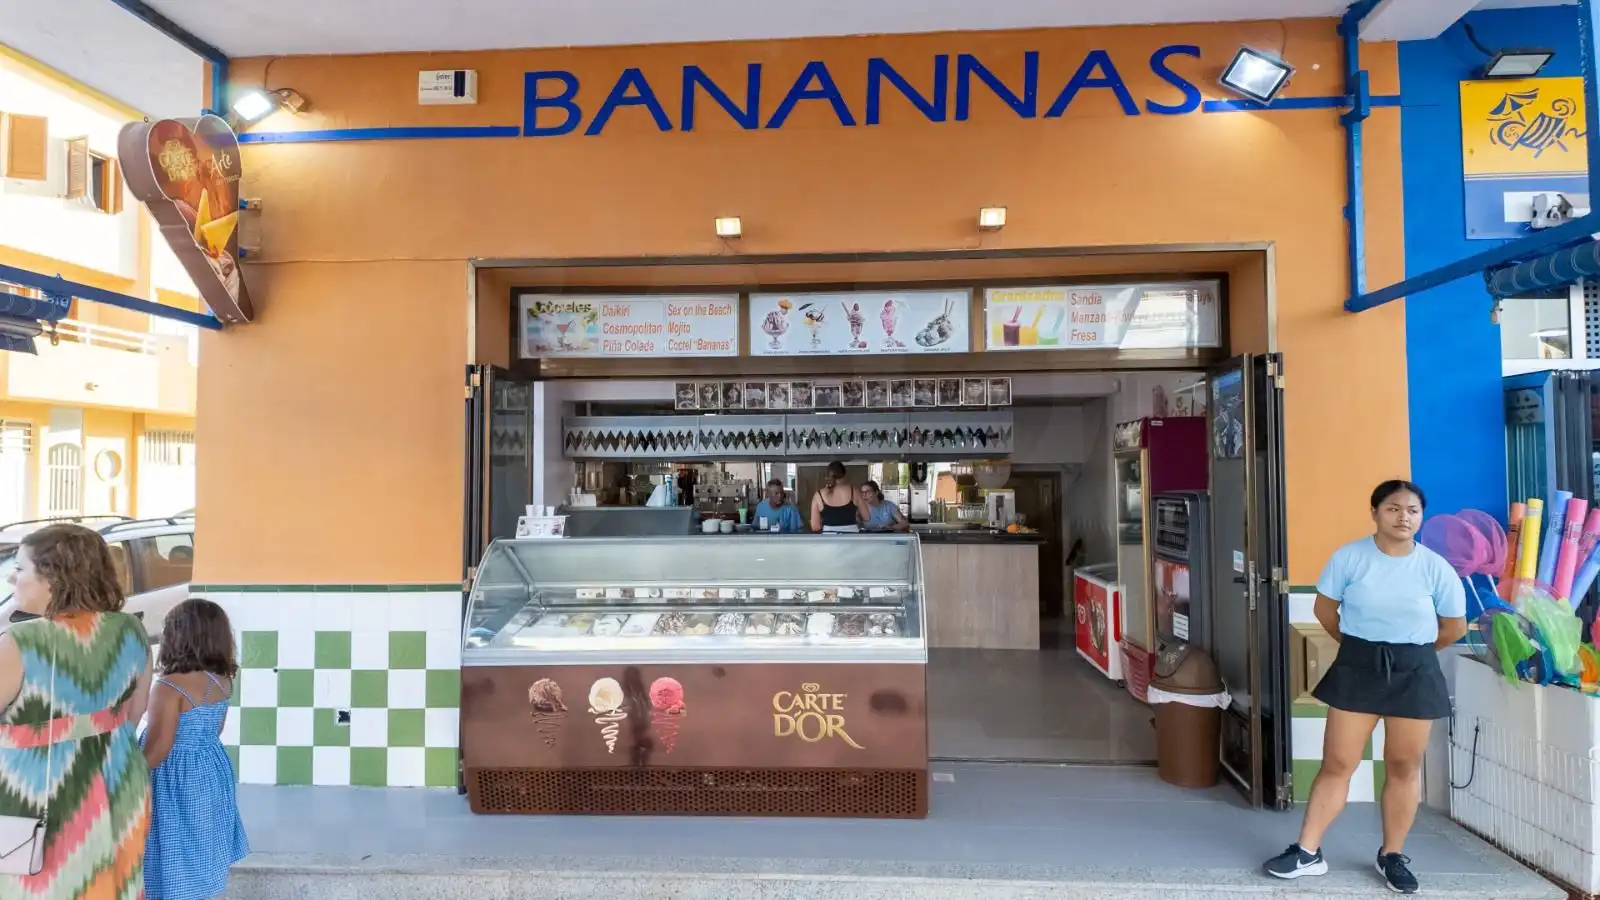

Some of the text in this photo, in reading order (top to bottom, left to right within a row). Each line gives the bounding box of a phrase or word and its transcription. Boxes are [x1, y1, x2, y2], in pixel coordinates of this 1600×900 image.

[523, 44, 1202, 137] BANANNAS
[210, 147, 233, 178] Arte
[602, 303, 630, 317] Daikiri
[667, 303, 732, 316] Sex on the Beach
[602, 321, 663, 336] Cosmopolitan
[667, 321, 691, 336] Mojito
[1071, 328, 1097, 342] Fresa
[602, 339, 654, 352] Piña Colada
[772, 691, 845, 714] CARTE
[773, 710, 866, 750] D'OR
